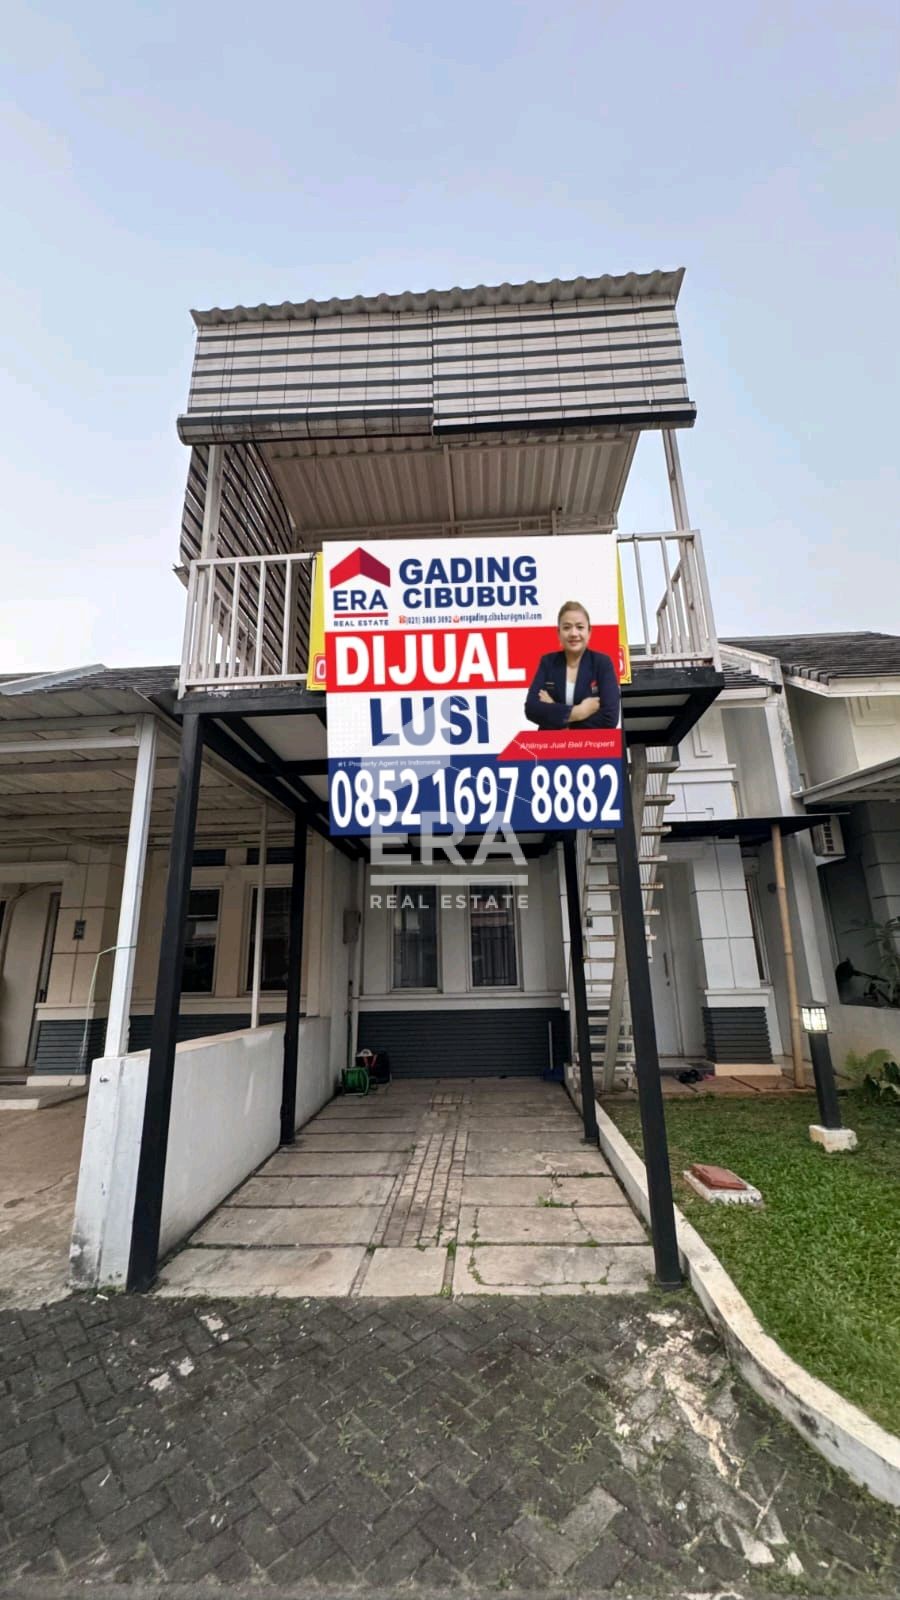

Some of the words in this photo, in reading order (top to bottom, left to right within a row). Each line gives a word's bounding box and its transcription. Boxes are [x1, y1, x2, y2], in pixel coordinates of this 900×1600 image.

[399, 556, 537, 585] GADING
[333, 589, 388, 611] ERA
[403, 585, 539, 609] CIBUBUR
[335, 632, 527, 687] DIJUAL
[370, 695, 490, 747] LUSI
[550, 741, 566, 749] Jual
[584, 740, 615, 749] Properti
[348, 760, 378, 768] Property
[331, 767, 421, 828] 0852
[433, 765, 519, 826] 1697
[531, 762, 621, 824] 8882
